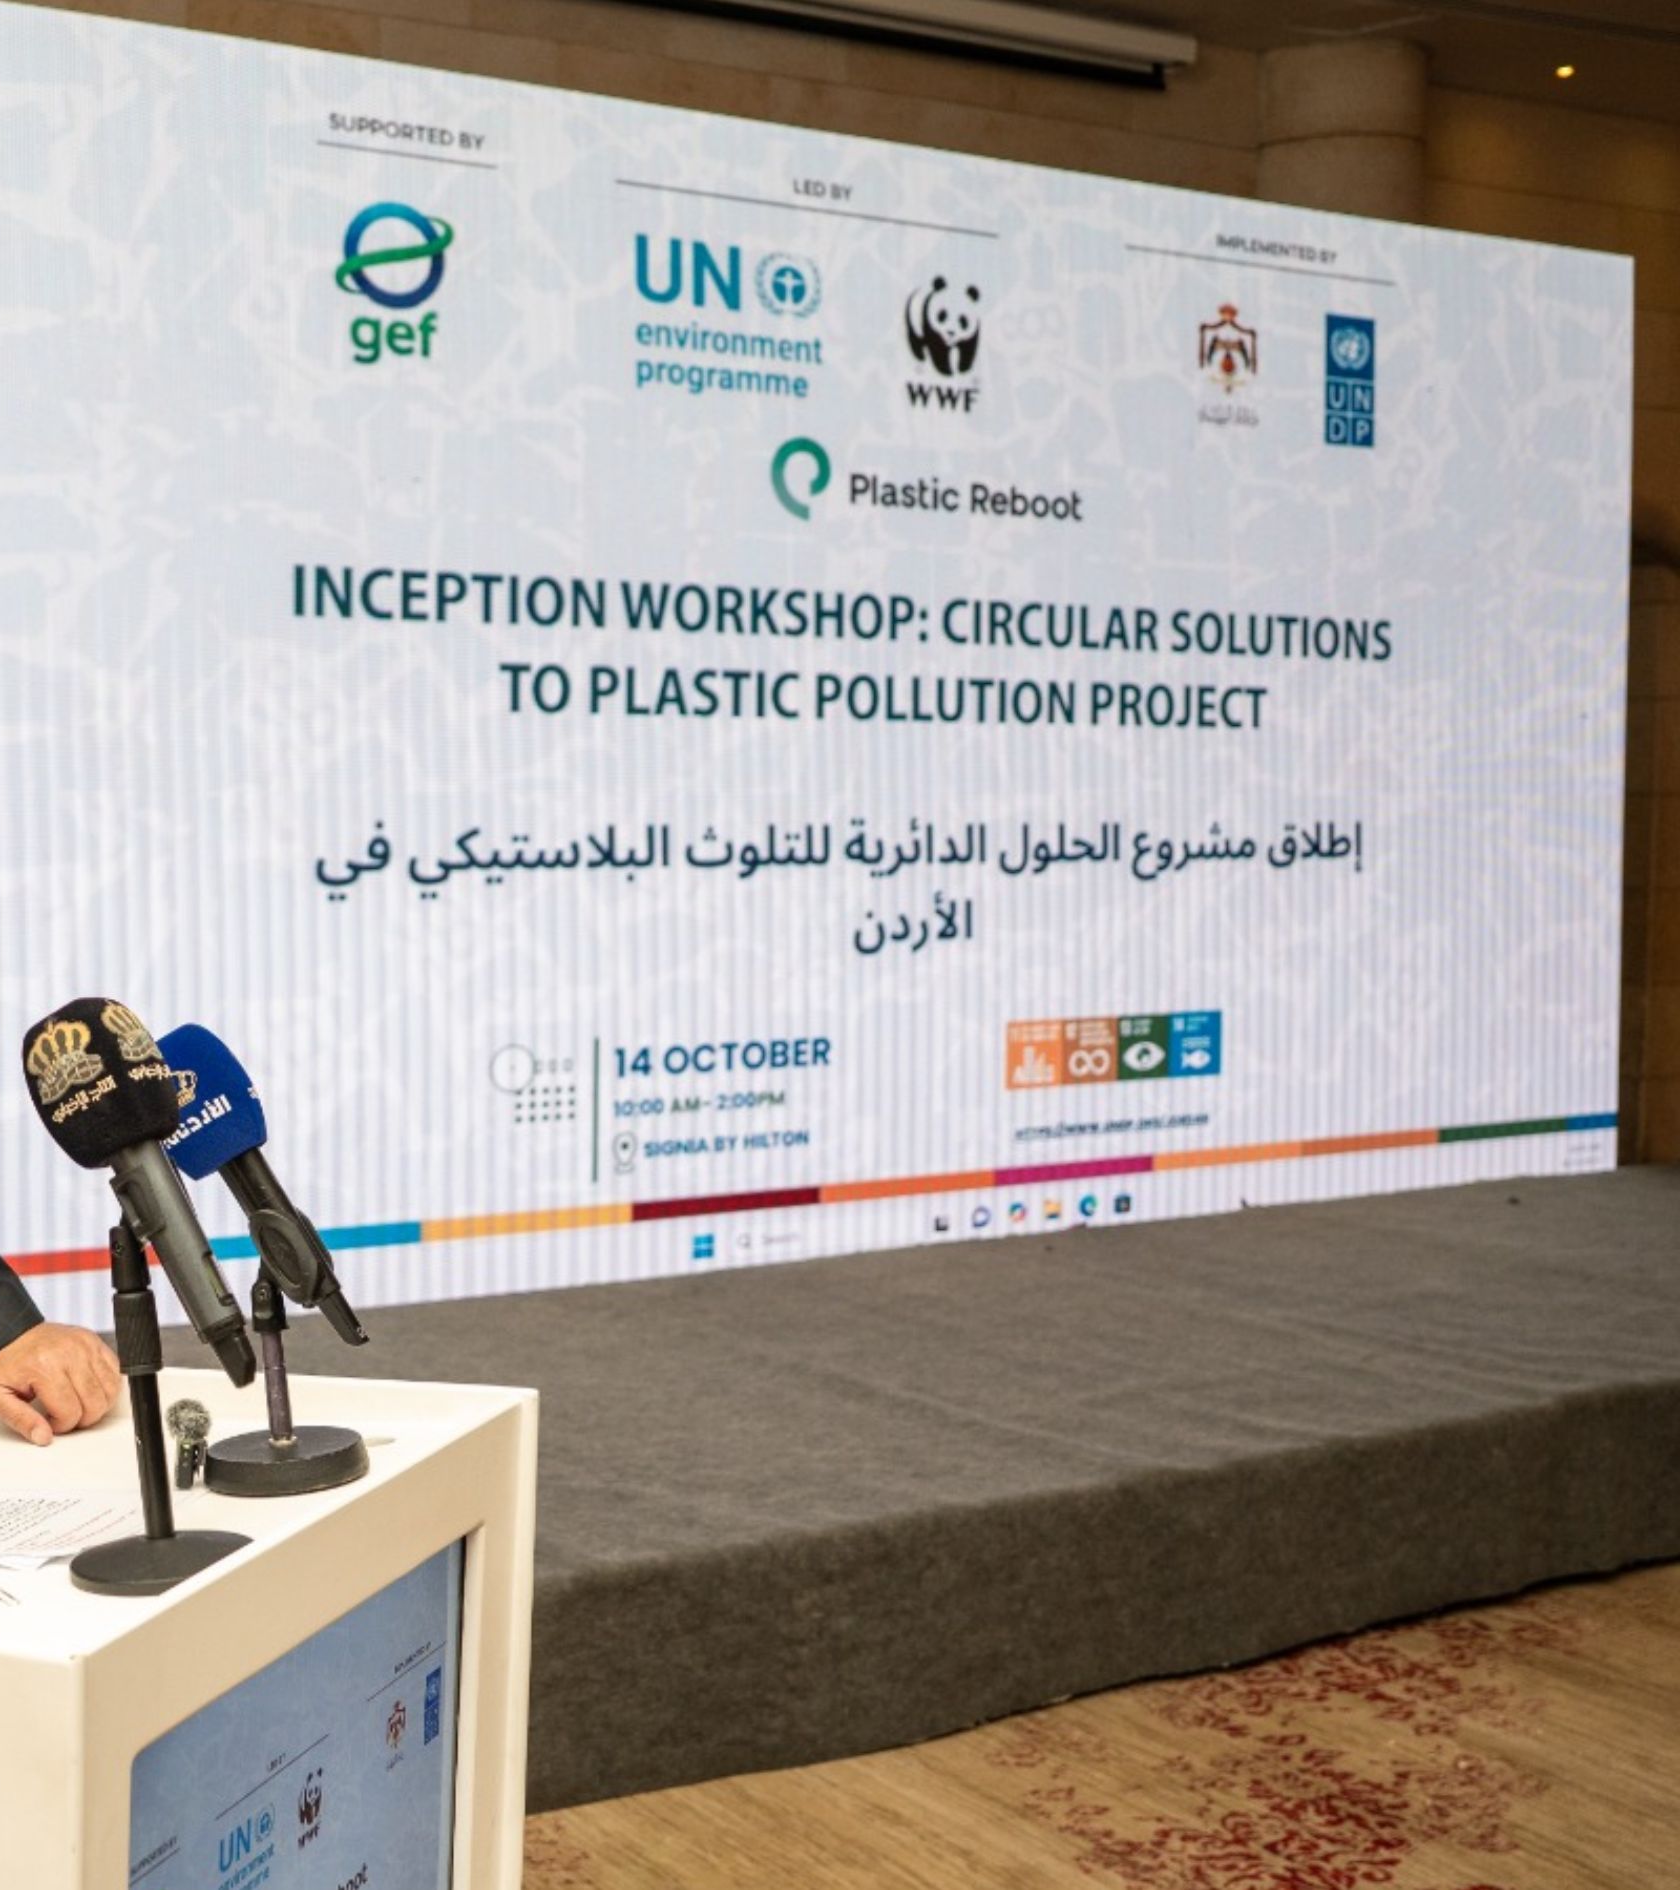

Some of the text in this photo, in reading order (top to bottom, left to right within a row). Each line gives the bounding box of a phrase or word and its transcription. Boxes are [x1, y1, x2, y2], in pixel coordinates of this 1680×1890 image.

[327, 111, 485, 150] SUPPORTED BY
[793, 179, 852, 200] LED BY
[1214, 234, 1318, 263] IMPLEMENTED
[635, 233, 742, 312] UN
[349, 311, 439, 365] gef
[634, 321, 824, 366] environment
[635, 358, 810, 399] programme
[906, 382, 978, 413] WWF
[849, 473, 1083, 522] Plastic Reboot
[293, 564, 1392, 662] INCEPTION WORKSHOP: CIRCULAR SOLUTIONS
[499, 663, 1268, 729] TO PLASTIC POLLUTION PROJECT
[315, 818, 1362, 902] إطلاق مشروع الحلول الدائرية للتلوث البلاستيكي في
[853, 891, 973, 956] الأردن
[615, 1036, 831, 1078] 14 OCTOBER
[613, 1097, 665, 1118] 10:00
[717, 1090, 786, 1111] 2:00PM
[643, 1130, 810, 1159] SIGNIA BY HILTON
[218, 1818, 252, 1872] UN
